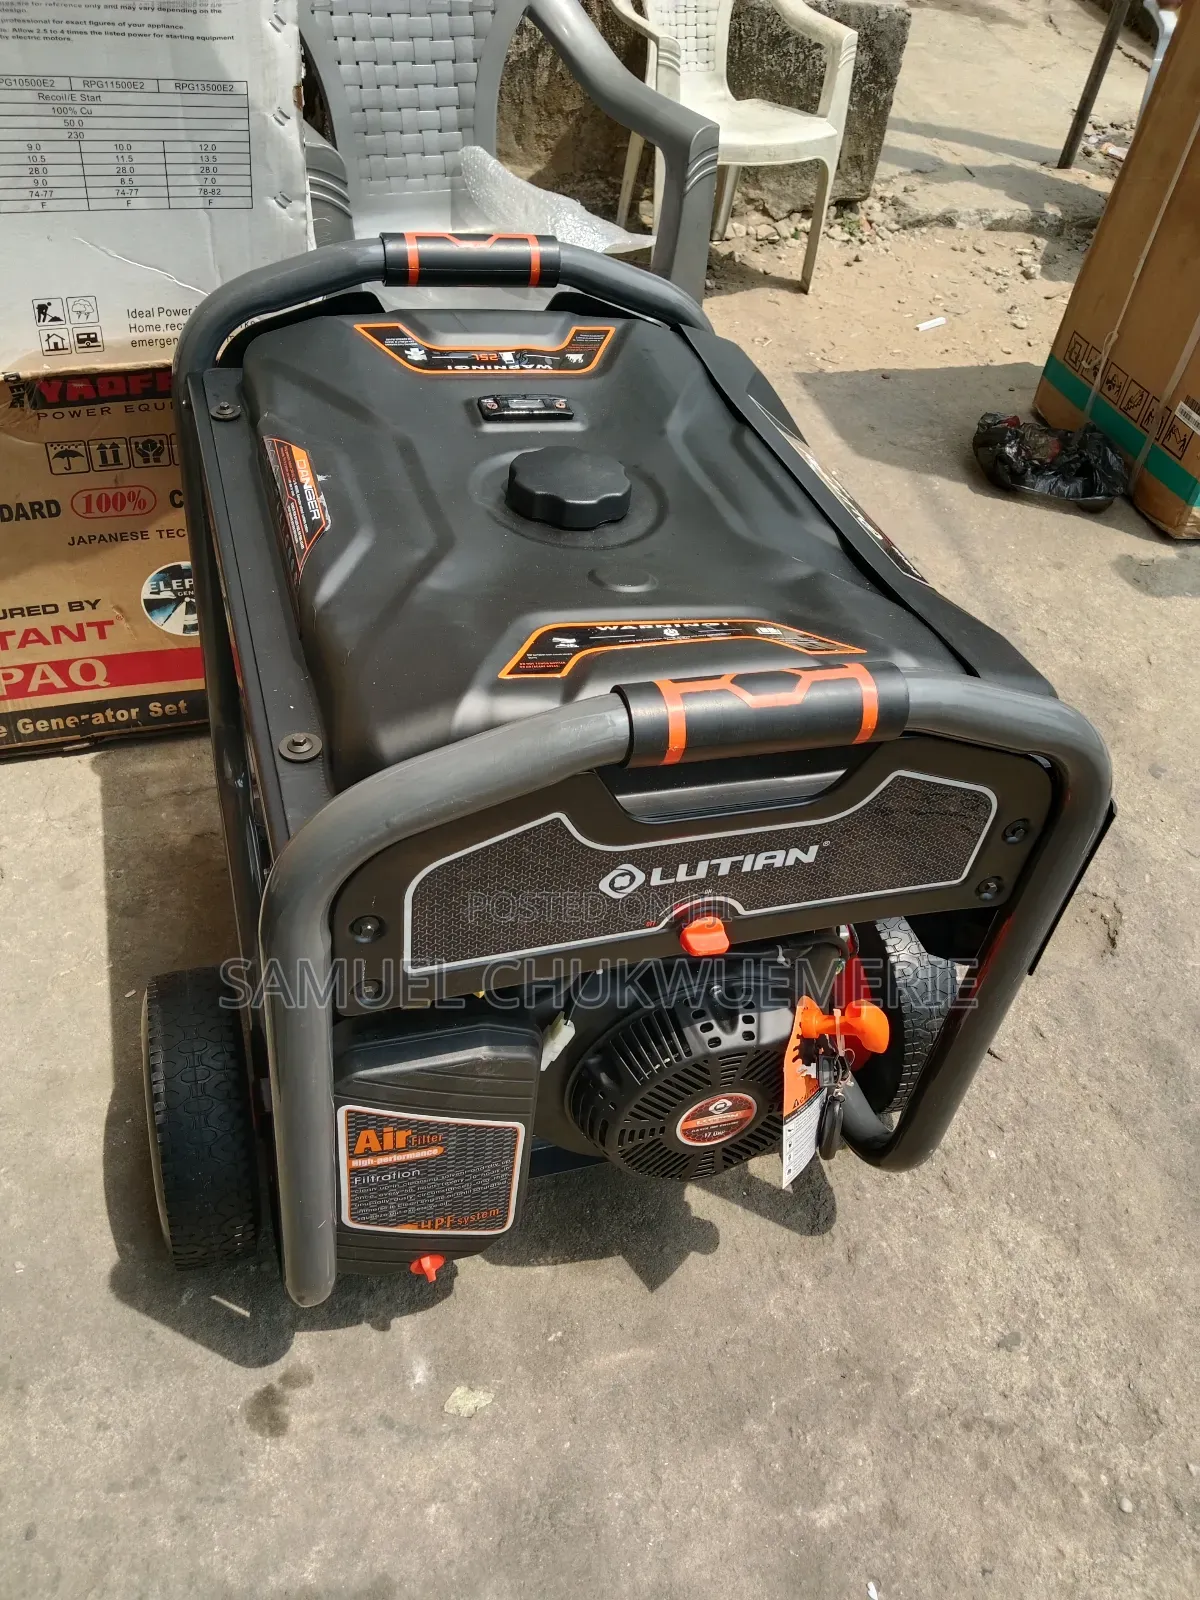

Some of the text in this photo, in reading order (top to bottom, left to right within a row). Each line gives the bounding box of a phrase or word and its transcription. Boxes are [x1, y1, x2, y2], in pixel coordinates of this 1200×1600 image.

[157, 6, 197, 14] depending
[82, 80, 145, 90] RPG11500E2
[174, 82, 234, 92] RPG13500E2
[37, 92, 102, 102] Recoil/E Start
[51, 106, 93, 115] 100% Cu
[63, 119, 84, 128] 50.0
[67, 131, 85, 140] 230
[26, 143, 41, 151] 9.0
[114, 143, 132, 151] 10.0
[199, 143, 217, 151] 12.0
[27, 155, 46, 163] 10.5
[28, 167, 48, 175] 28.0
[116, 166, 135, 174] 28.0
[199, 166, 218, 174] 28.0
[33, 178, 48, 186] 9.0
[120, 177, 134, 185] 8.5
[203, 177, 217, 185] 7.0
[28, 190, 54, 198] 74-77
[115, 188, 139, 196] 74-77
[41, 201, 47, 209] F
[126, 199, 132, 207] F
[127, 306, 192, 319] Ideal Power
[128, 322, 186, 333] Home,rec
[36, 406, 112, 421] POWER
[296, 459, 321, 521] DANGER
[0, 489, 184, 523] DARD 100% C
[67, 528, 186, 546] JAPANESE TEC
[148, 578, 194, 592] ELEP
[67, 598, 102, 613] BY
[0, 620, 115, 651] TANT
[0, 658, 111, 696] PAQ
[149, 699, 188, 719] Set
[650, 844, 820, 887] LUTIAN
[353, 1126, 444, 1155] Air Filter
[351, 1148, 439, 1168] High-performance
[354, 1169, 421, 1185] Filtration
[457, 1208, 499, 1225] system
